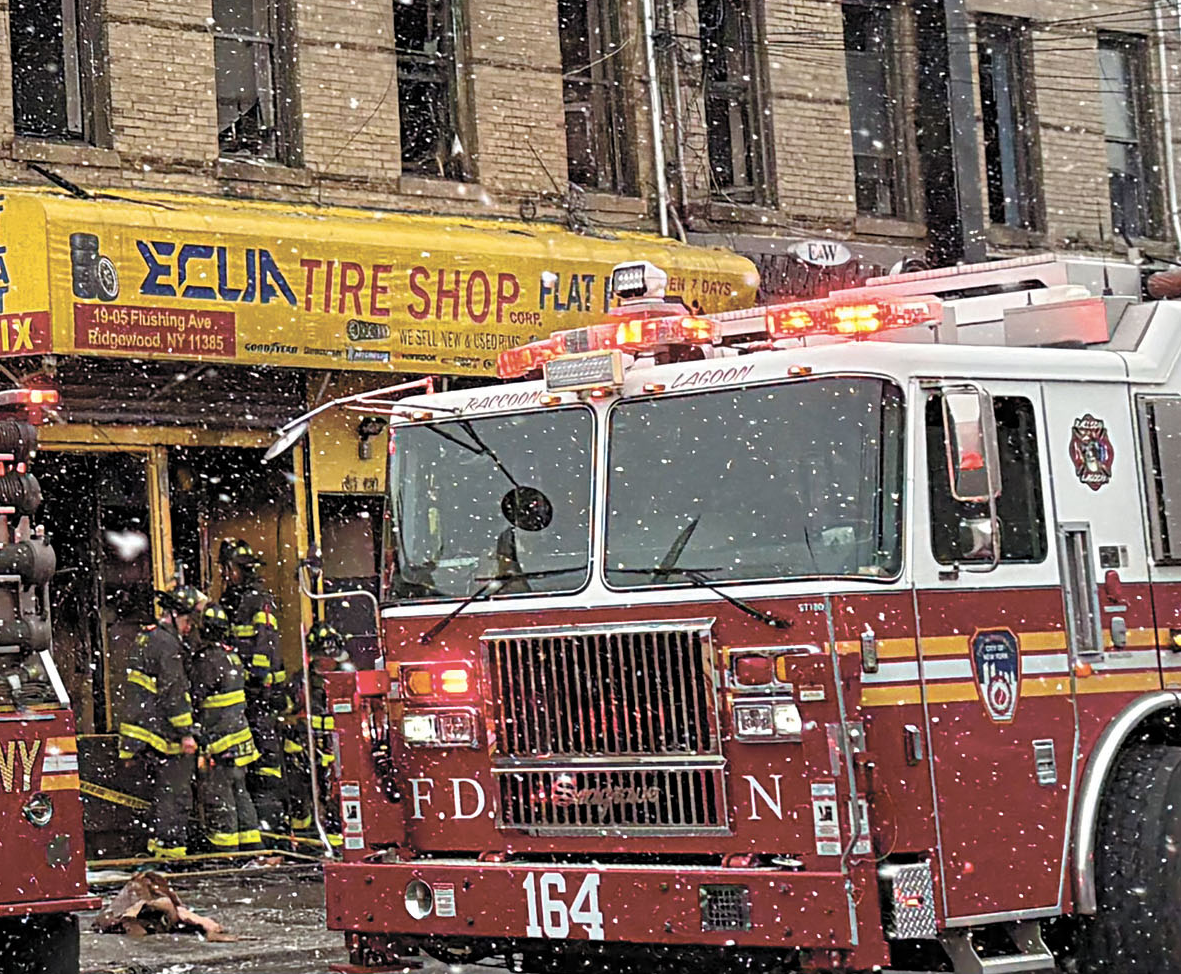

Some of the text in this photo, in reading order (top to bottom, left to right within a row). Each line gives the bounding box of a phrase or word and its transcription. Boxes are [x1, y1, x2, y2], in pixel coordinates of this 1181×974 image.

[300, 258, 394, 317] TIRE
[407, 265, 521, 324] SHOP
[539, 272, 595, 313] FLAT
[701, 279, 732, 296] DAYS
[93, 308, 128, 325] 19-05
[131, 310, 185, 331] Flushing
[167, 332, 186, 348] NY
[188, 334, 224, 351] 11385
[399, 329, 414, 346] WE
[441, 331, 461, 348] NEW
[473, 333, 497, 350] USED
[670, 364, 755, 389] LAGOON
[464, 389, 543, 411] RACCOON
[522, 871, 605, 940] 164
